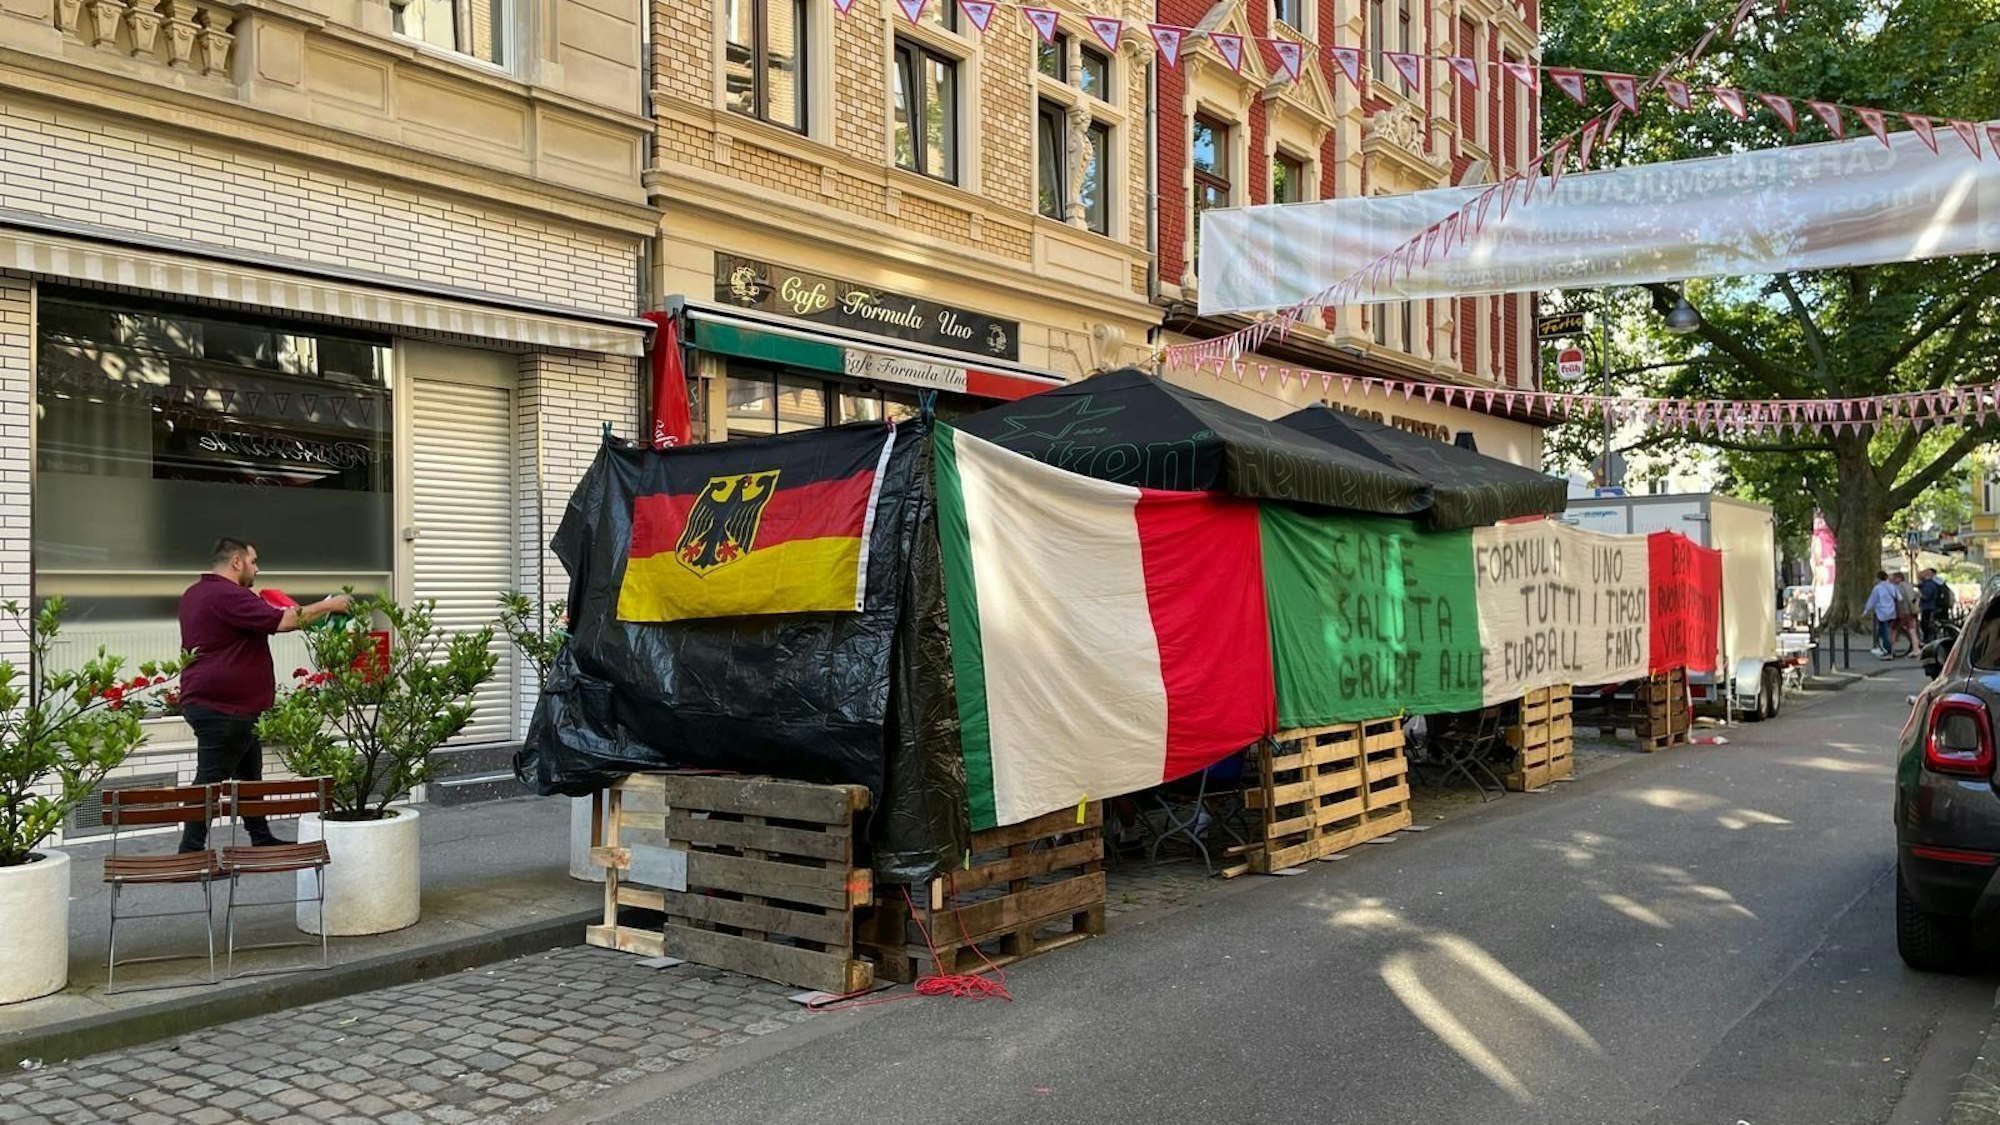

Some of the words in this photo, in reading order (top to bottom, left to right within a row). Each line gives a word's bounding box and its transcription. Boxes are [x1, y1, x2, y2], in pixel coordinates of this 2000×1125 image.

[781, 276, 829, 315] Cafe
[843, 291, 924, 330] Formula
[938, 311, 974, 340] Uno
[876, 358, 939, 382] Formula
[1333, 533, 1418, 587] CAFE
[1476, 537, 1562, 589] FORMULA
[1592, 543, 1624, 585] UNO
[1335, 588, 1453, 644] SALUTA
[1520, 581, 1582, 626] TUTTI
[1606, 588, 1647, 625] TIFOSI
[1440, 646, 1490, 691] ALLE
[1606, 626, 1642, 670] FANS
